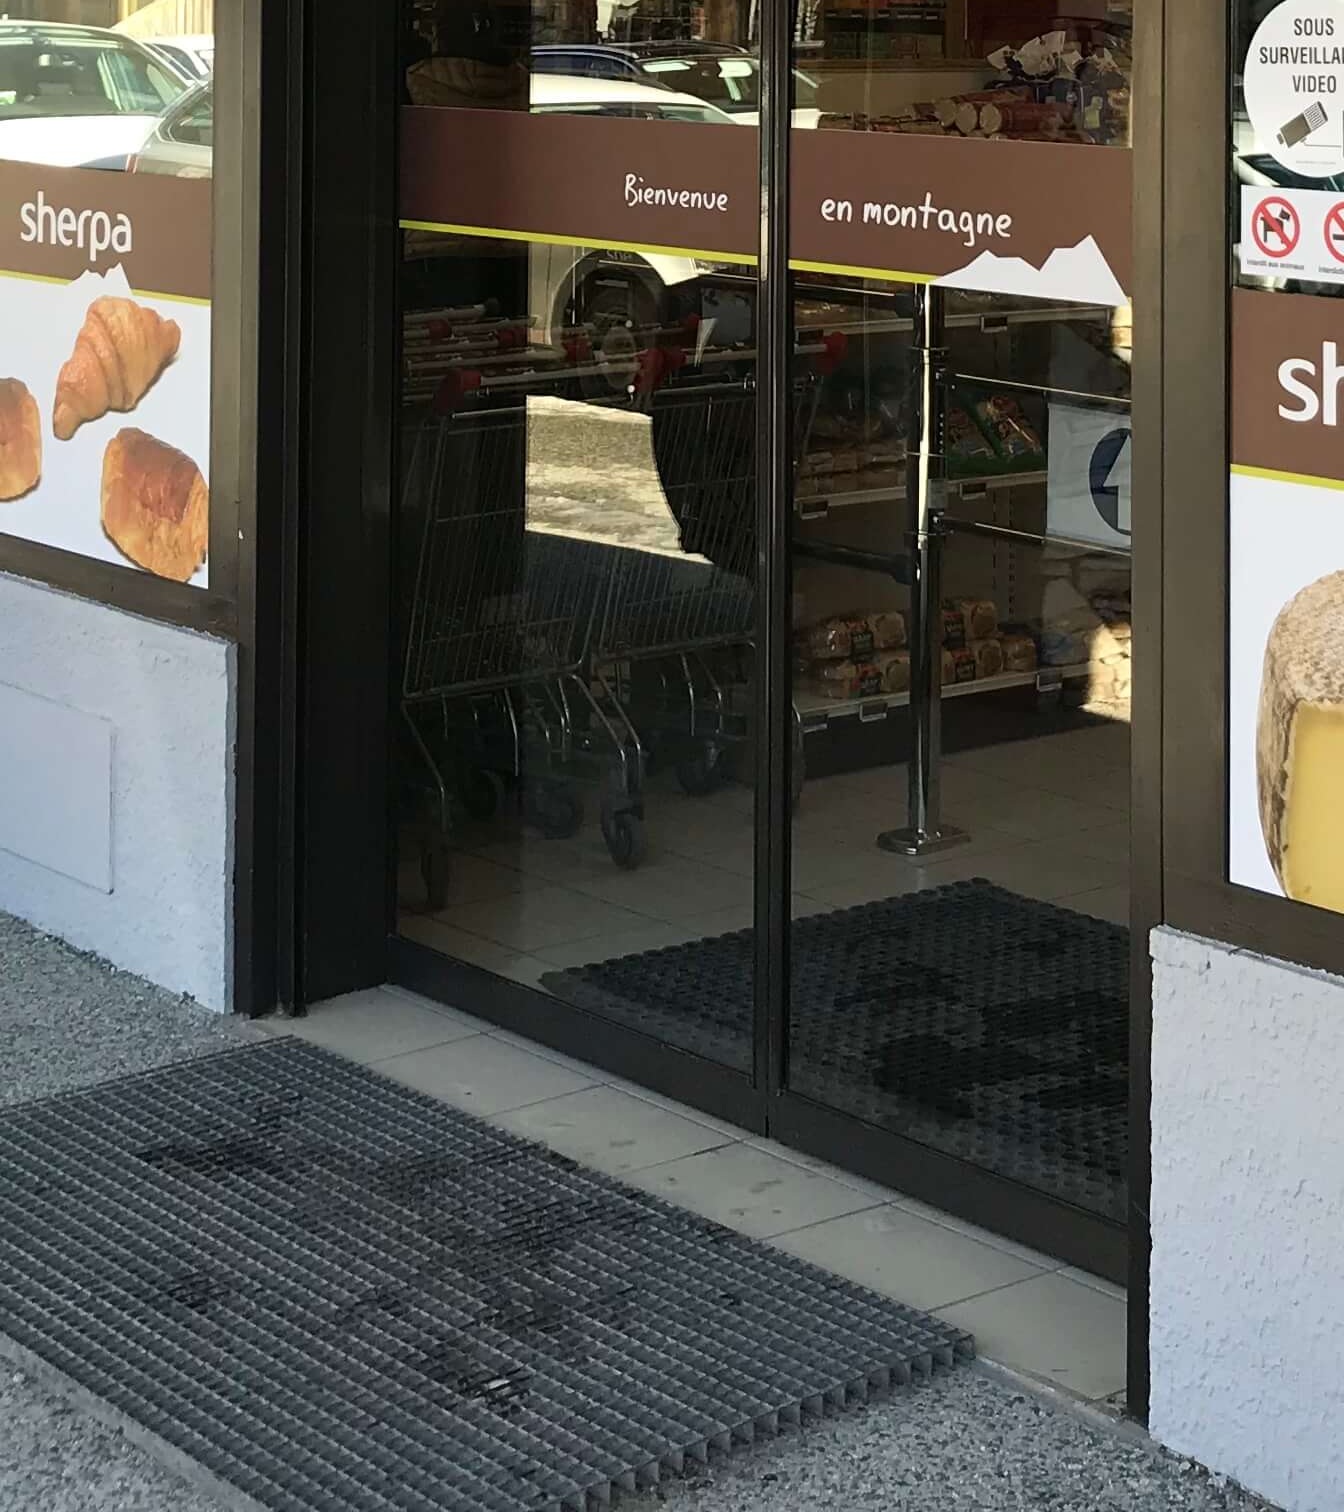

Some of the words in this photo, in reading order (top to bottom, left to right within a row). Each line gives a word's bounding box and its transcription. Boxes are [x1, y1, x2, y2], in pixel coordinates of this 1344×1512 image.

[1293, 17, 1335, 37] SOUS
[1292, 74, 1337, 94] VIDEO
[20, 190, 133, 262] sherpa
[624, 173, 729, 212] Bienvenue
[821, 197, 853, 223] en
[862, 191, 1013, 247] montagne
